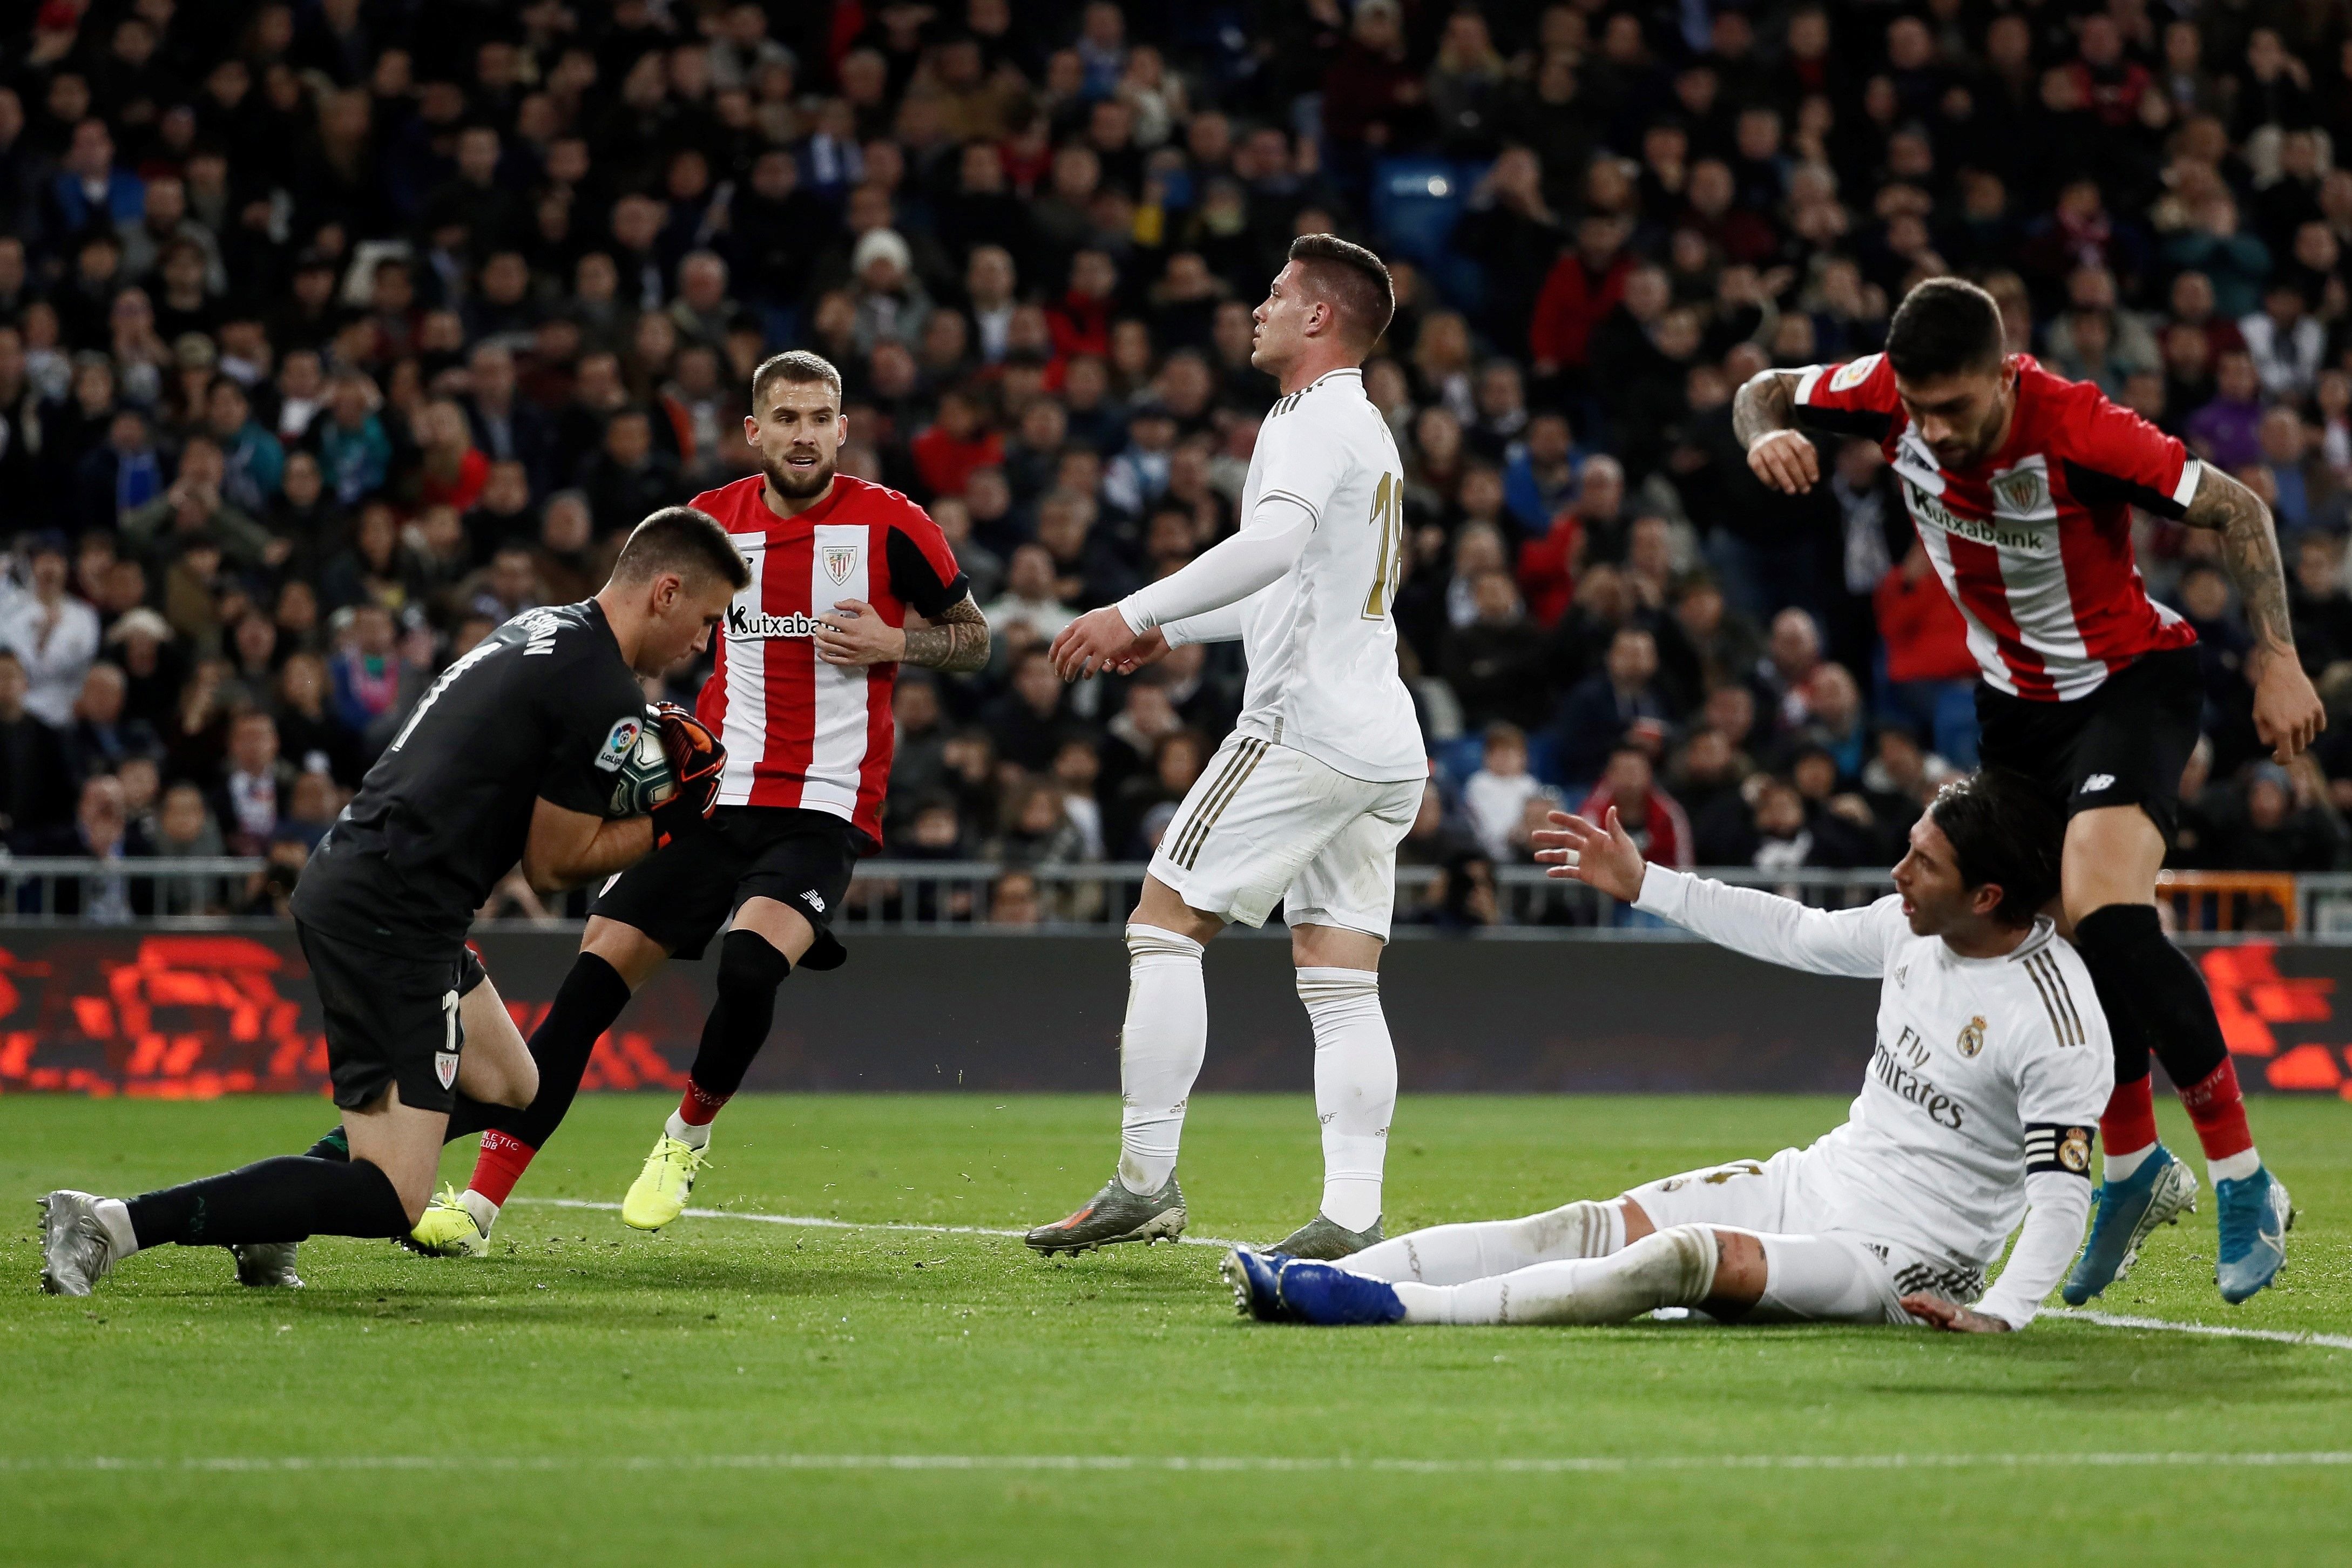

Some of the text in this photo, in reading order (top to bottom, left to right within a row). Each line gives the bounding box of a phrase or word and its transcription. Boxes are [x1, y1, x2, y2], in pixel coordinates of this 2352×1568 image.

[1909, 481, 2042, 550] Kutxabank
[727, 601, 843, 634] Kutxaba
[391, 641, 503, 752] 1
[442, 989, 459, 1051] 1
[1895, 1025, 1931, 1070] Fly
[1875, 1031, 1964, 1130] mirates
